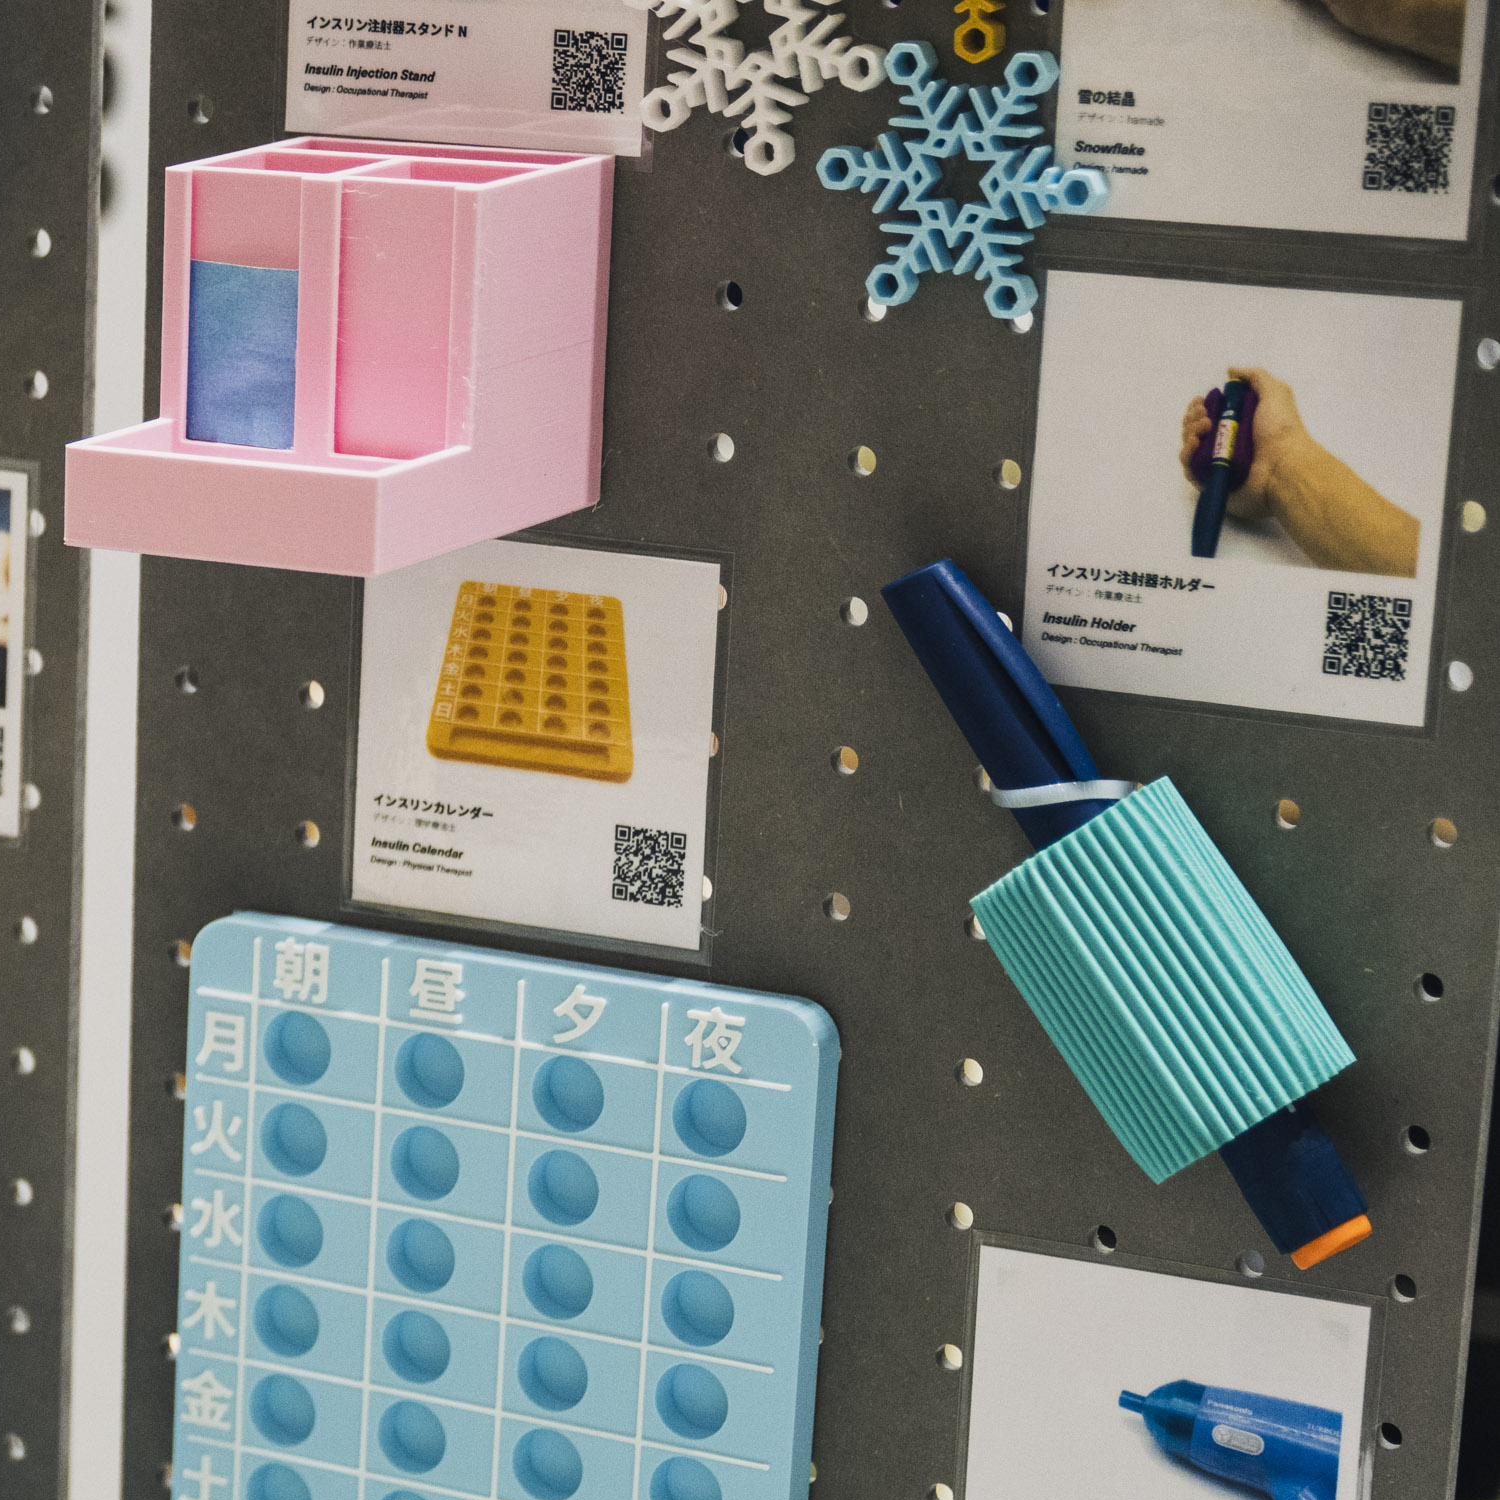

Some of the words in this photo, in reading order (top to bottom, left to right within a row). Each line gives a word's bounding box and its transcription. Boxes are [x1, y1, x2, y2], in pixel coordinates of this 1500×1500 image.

[306, 16, 454, 37] インスリン注射器スタンド
[458, 25, 468, 38] N
[305, 63, 344, 77] Insulin
[346, 65, 398, 81] Injection
[400, 69, 435, 82] Stand
[304, 83, 331, 96] Design
[336, 85, 389, 99] Occupational
[390, 88, 428, 101] Therapist
[1077, 89, 1136, 107] 雪の結晶
[1074, 140, 1146, 156] Snowflake
[1047, 563, 1216, 592] インスリン注射器ホルダー
[1042, 611, 1088, 627] Insulin
[1090, 617, 1137, 633] Holder
[1041, 631, 1073, 645] Design
[1079, 635, 1139, 652] Occupational
[1140, 643, 1183, 656] Therapist
[374, 793, 494, 820] インスリンカレンダー
[371, 837, 410, 852] Insulin
[412, 842, 464, 860] Calendar
[273, 937, 330, 1006] 朝
[408, 961, 466, 1026] 昼
[551, 983, 609, 1047] 夕
[686, 1005, 747, 1075] 夜
[195, 1010, 247, 1076] 月
[190, 1099, 243, 1163] 火
[190, 1189, 244, 1250] 水
[183, 1281, 238, 1340] 木
[180, 1370, 234, 1434] 金
